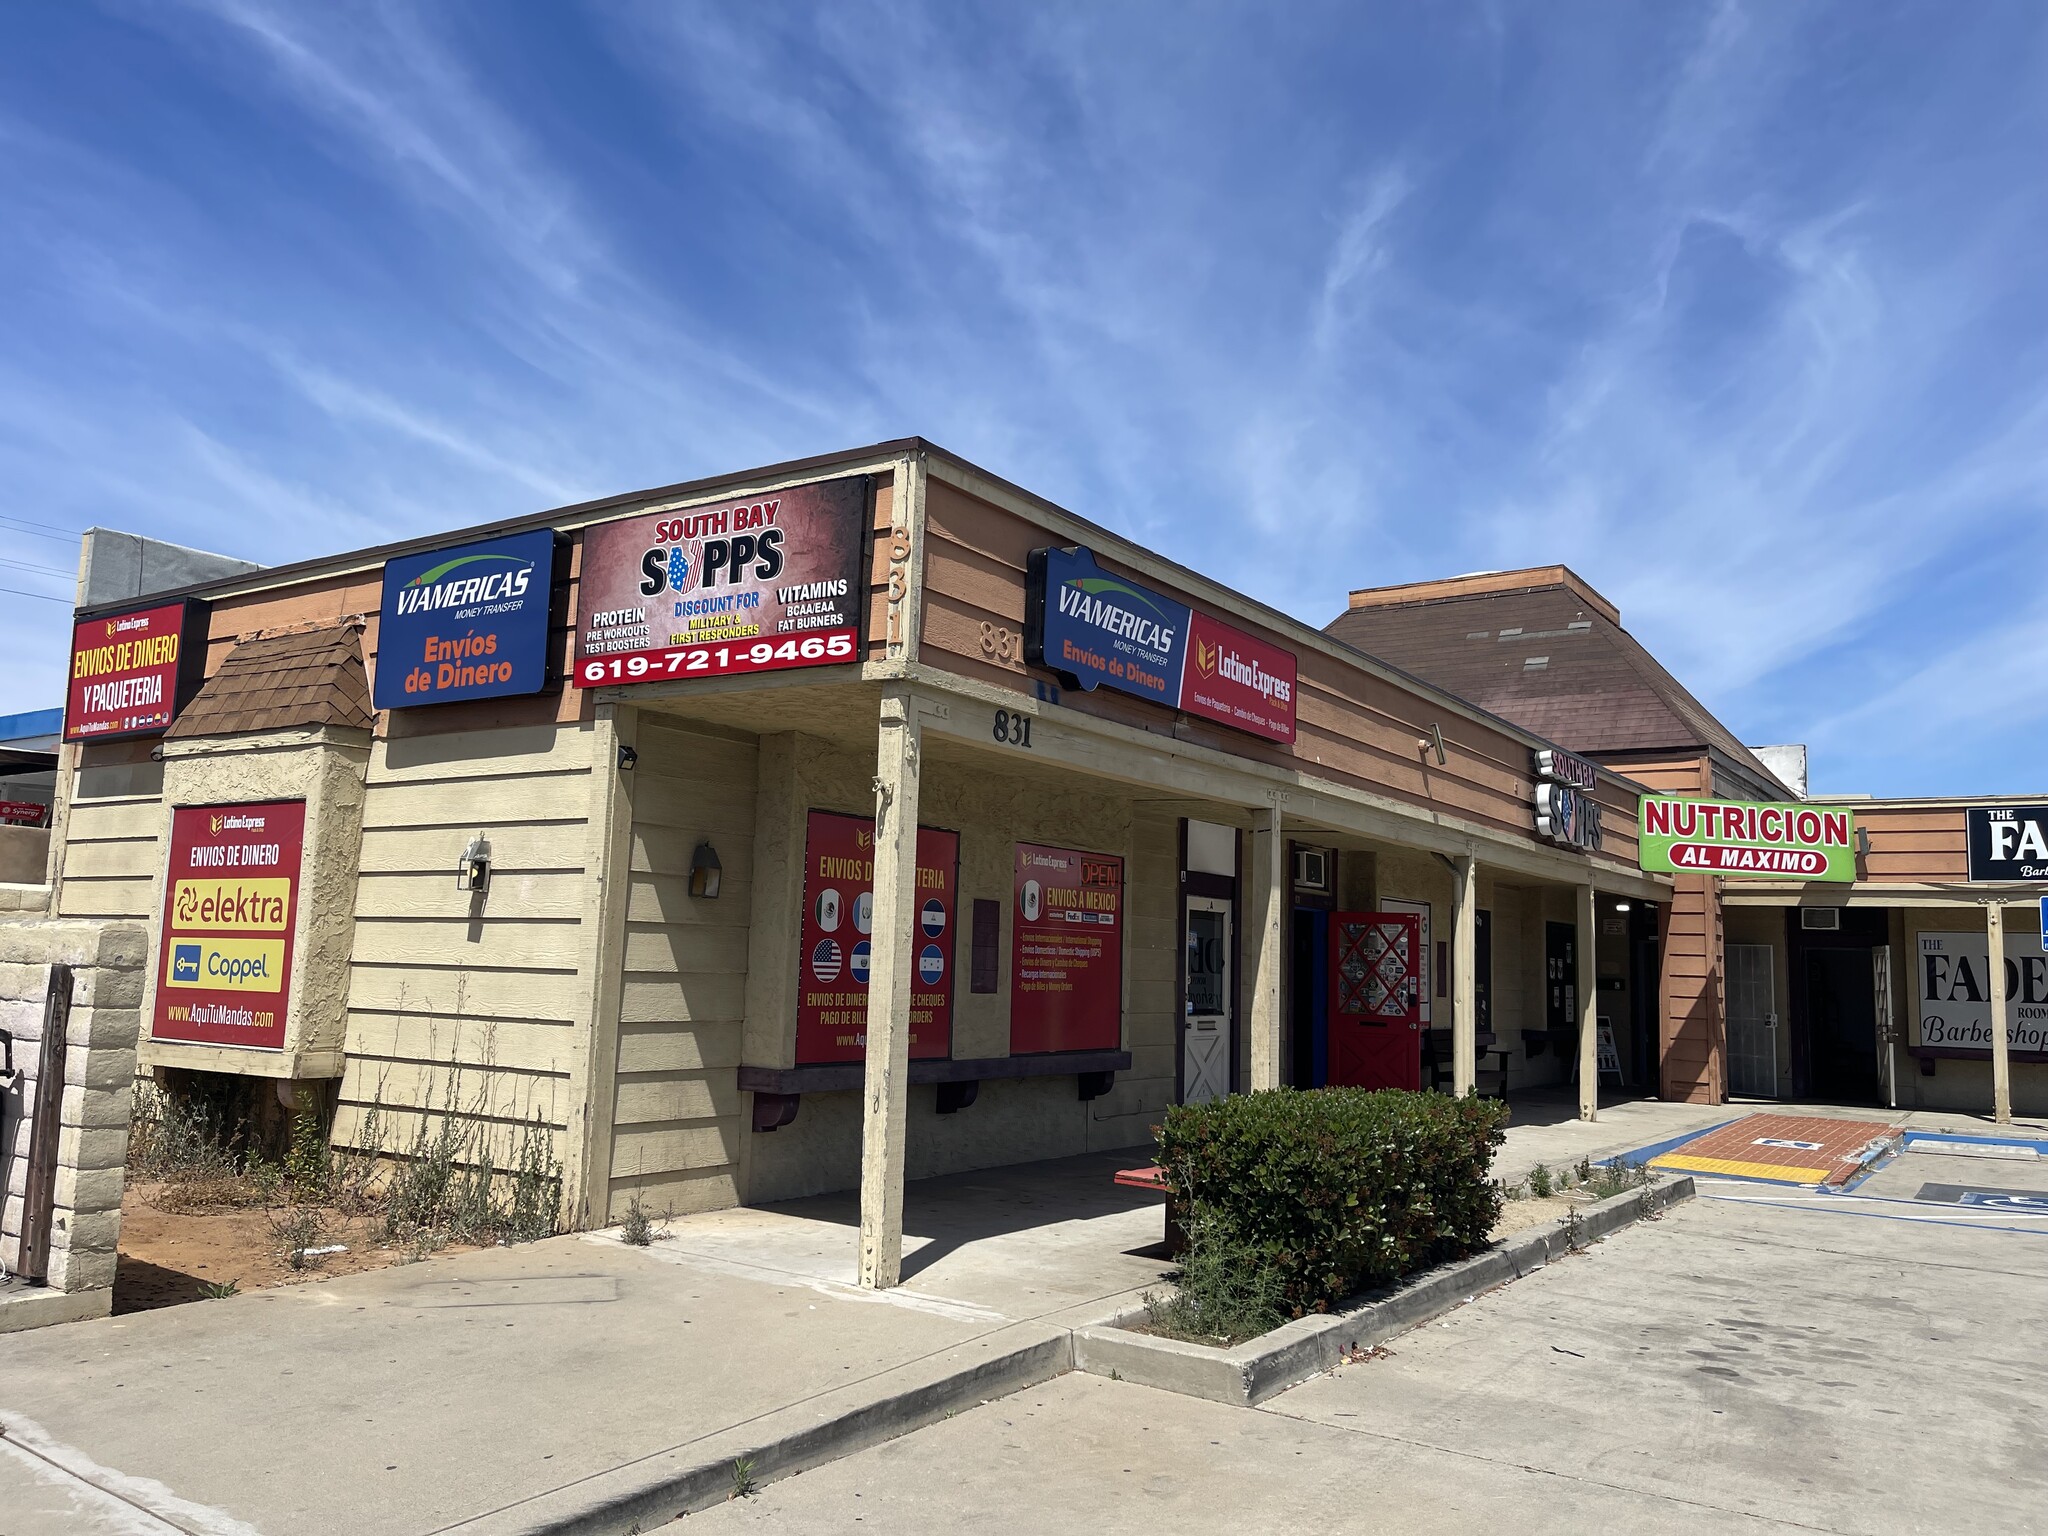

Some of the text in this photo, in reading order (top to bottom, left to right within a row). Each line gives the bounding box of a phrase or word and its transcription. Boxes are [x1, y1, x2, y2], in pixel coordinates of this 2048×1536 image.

[655, 500, 781, 544] SOUTH BAY
[397, 568, 533, 615] VIAMERICAS
[777, 579, 848, 605] VITAMINS
[455, 600, 523, 620] MONEY TRANSFER
[592, 607, 646, 628] PROTEIN
[674, 591, 760, 619] DISCOUNT FOR
[787, 601, 834, 617] BCAA/EAA
[689, 613, 741, 630] MILITARY &
[777, 614, 844, 632] FAT BURNERS
[1059, 585, 1174, 653] VIAMERICAS
[424, 629, 497, 662] Envíos
[585, 637, 651, 654] TEST BOOSTERS
[586, 625, 650, 642] PRE WORKOUTS
[670, 624, 760, 645] FIRST RESPONDERS
[980, 620, 1024, 661] 831
[74, 633, 179, 679] ENVIOS DE DINERO
[585, 635, 851, 681] 619-721-9465
[1063, 639, 1166, 692] Envíos de Dinero
[1113, 639, 1169, 667] MONEY TRANSFER
[404, 659, 512, 694] de Dinero
[84, 674, 162, 714] Y PAQUETERIA
[993, 709, 1032, 748] 831
[1645, 799, 1850, 847] NUTRICION
[1988, 810, 2014, 820] THE
[190, 844, 279, 867] ENVIOS DE DINERO
[819, 855, 862, 881] ENVIOS
[864, 862, 873, 881] D
[1681, 847, 1817, 871] AL MAXIMO
[1081, 862, 1116, 887] OPEN
[200, 886, 283, 923] elektra
[1047, 887, 1116, 911] ENVIOS A MEXICO
[1922, 939, 1944, 950] THE
[208, 952, 268, 984] Coppel
[807, 993, 834, 1007] ENVIOS
[835, 993, 845, 1007] DE
[845, 993, 868, 1006] DINER
[917, 993, 945, 1007] CHEQUES
[168, 1003, 274, 1028] www.AquiTuMandas.com
[820, 1011, 840, 1025] PAGO
[841, 1011, 850, 1024] DE
[1923, 1015, 2048, 1051] Barbeshop
